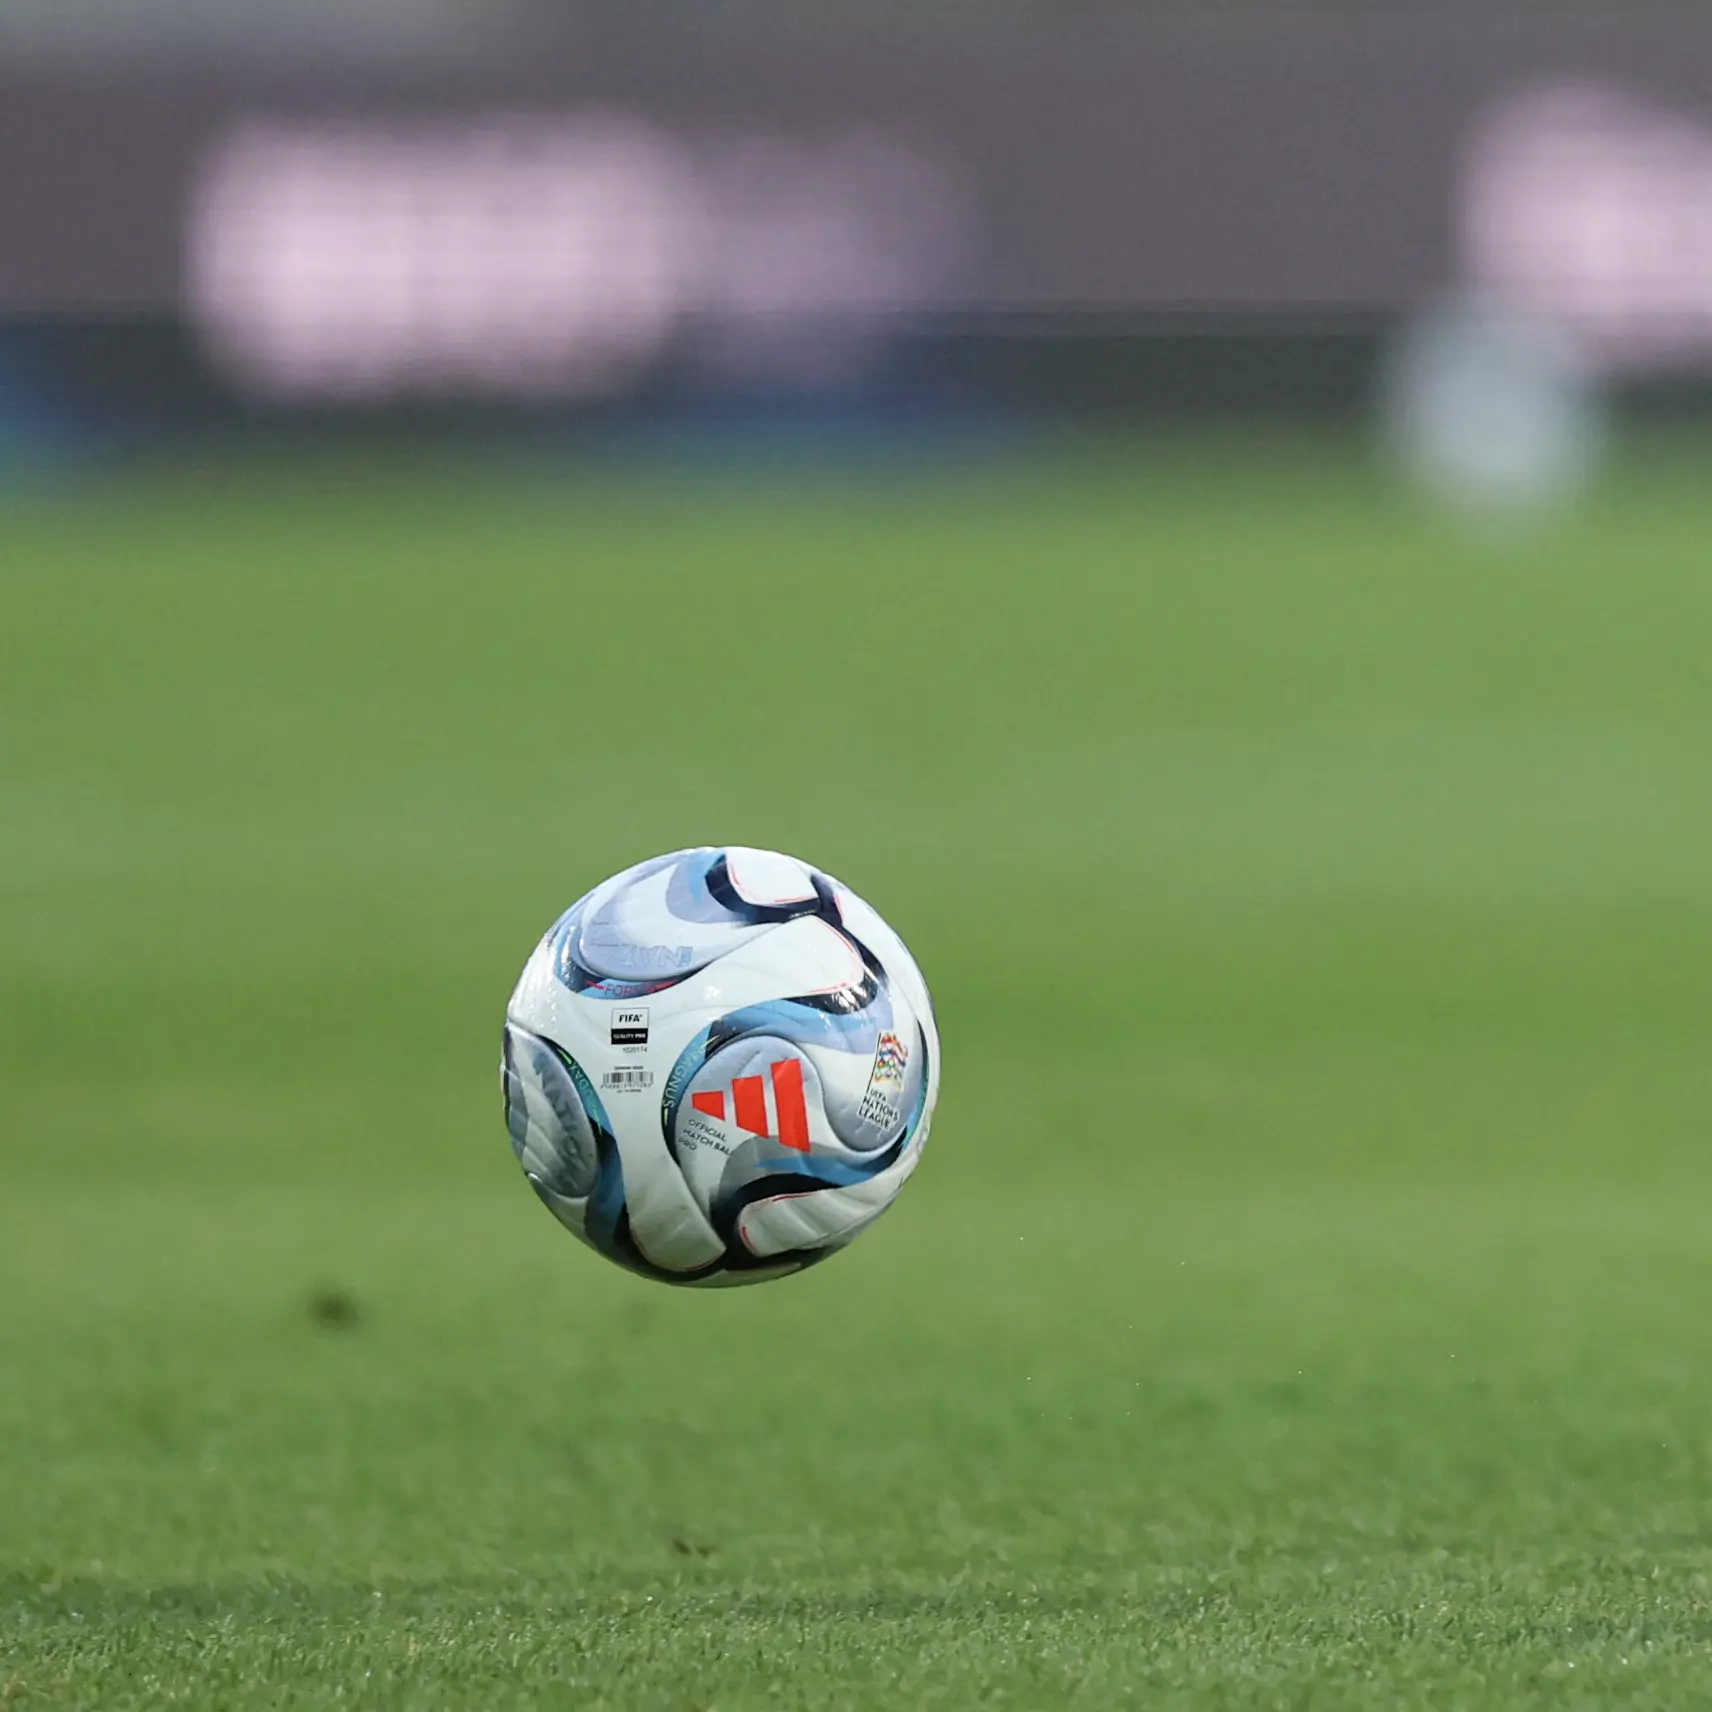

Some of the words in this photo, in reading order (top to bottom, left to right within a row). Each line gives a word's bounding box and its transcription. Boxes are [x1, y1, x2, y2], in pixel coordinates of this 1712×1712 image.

[618, 1014, 642, 1023] FIFA
[862, 1096, 899, 1121] NATIONS
[683, 1129, 714, 1149] MATCH
[688, 1119, 727, 1142] OFFICIAL
[677, 1137, 698, 1152] PRO
